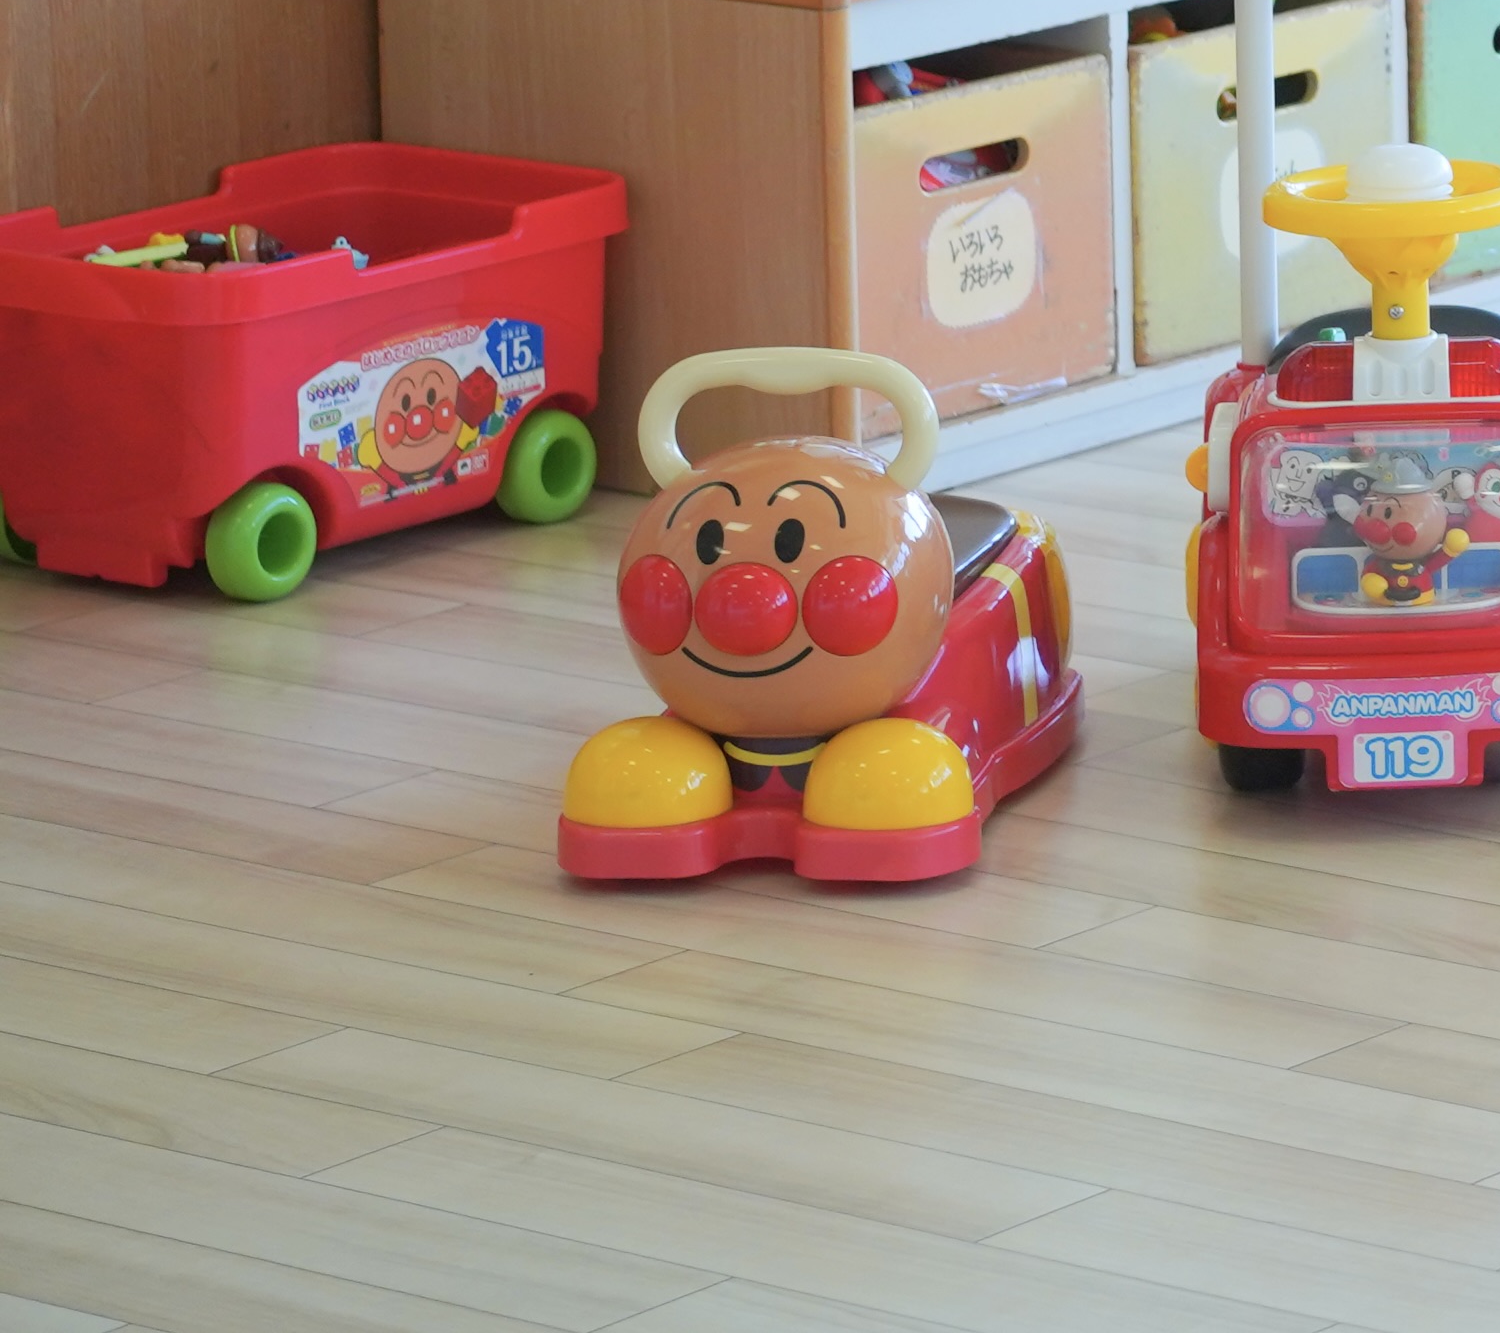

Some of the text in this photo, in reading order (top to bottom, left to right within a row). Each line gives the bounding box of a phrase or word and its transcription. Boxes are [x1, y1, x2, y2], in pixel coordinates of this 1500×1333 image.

[948, 223, 1004, 264] いろいろ
[959, 258, 1015, 294] おもちゃ
[1330, 689, 1474, 719] ANPANMAN
[1365, 735, 1444, 780] 119
